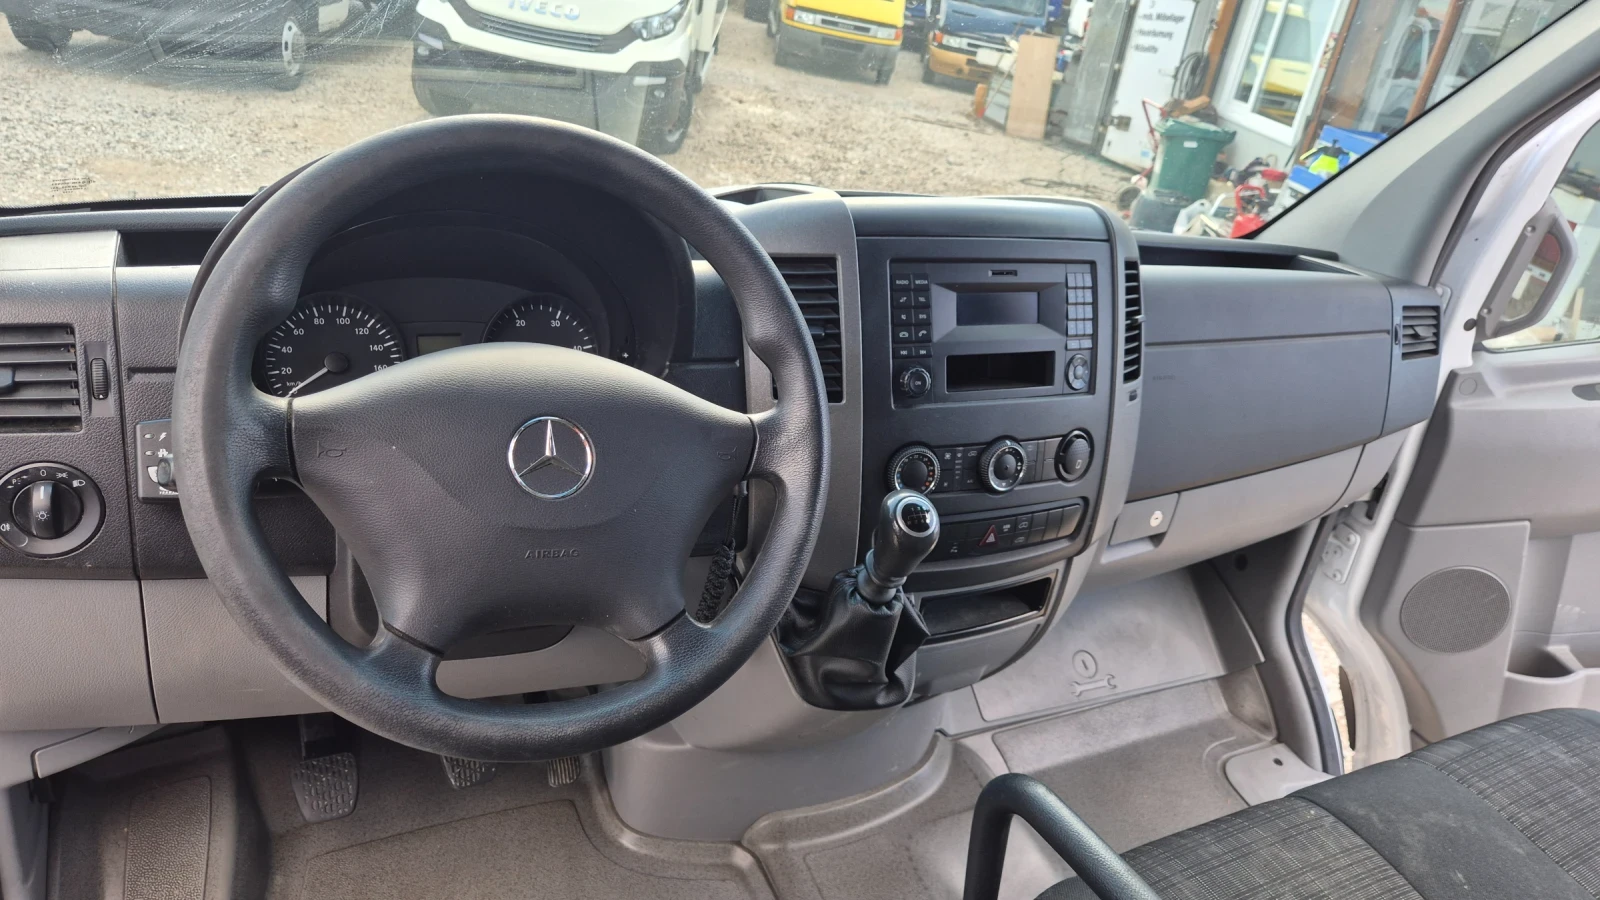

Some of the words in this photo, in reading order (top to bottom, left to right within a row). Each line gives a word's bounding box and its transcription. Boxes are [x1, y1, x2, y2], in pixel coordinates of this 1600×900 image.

[507, 0, 581, 20] IVECO
[281, 367, 292, 375] 20
[524, 548, 580, 559] AIRBAG
